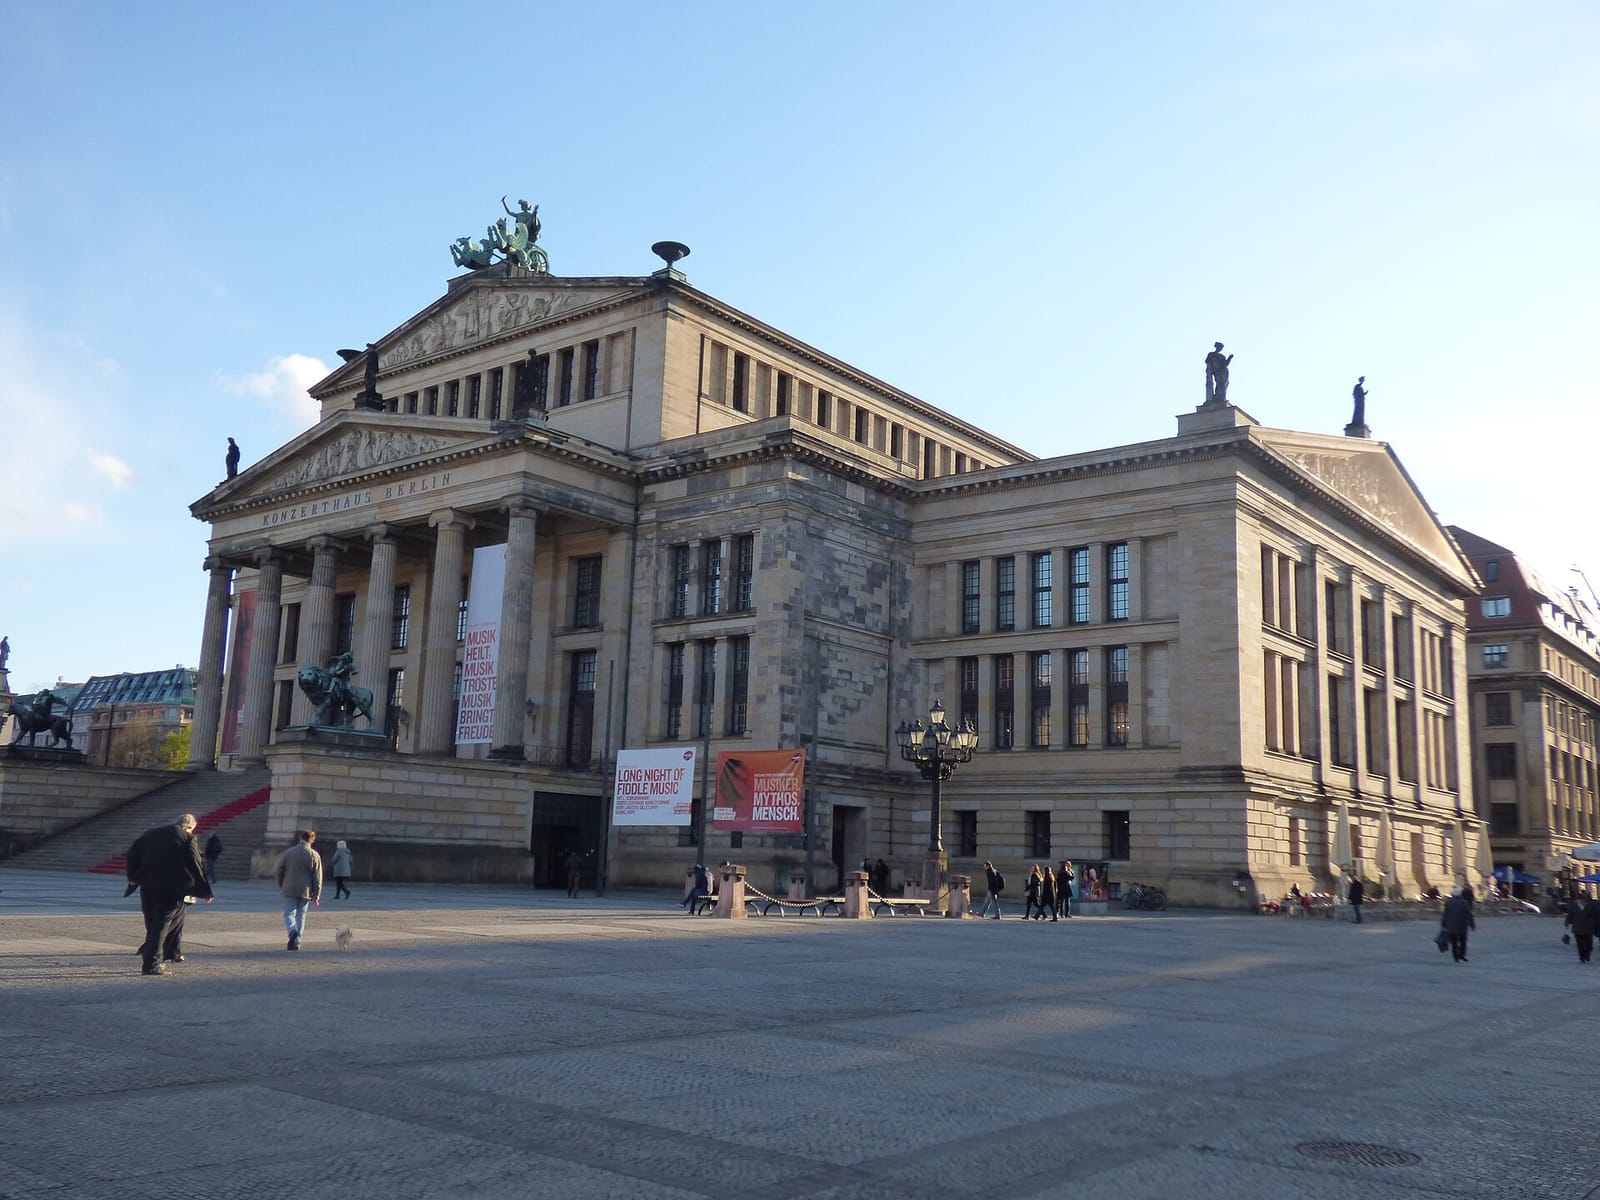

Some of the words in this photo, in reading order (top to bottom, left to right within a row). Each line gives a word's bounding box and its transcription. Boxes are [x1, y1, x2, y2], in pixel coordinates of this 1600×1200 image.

[263, 492, 371, 526] KONZERTHAUS
[385, 473, 450, 499] BERLIN
[467, 628, 496, 646] MUSIK
[464, 661, 494, 677] MUSIK
[461, 693, 492, 709] MUSIK
[460, 708, 495, 725] BRINGT
[618, 769, 642, 782] LONG
[644, 768, 672, 782] NIGHT
[674, 768, 685, 781] OF
[617, 782, 648, 795] FIDDLE
[650, 782, 679, 795] MUSIC
[754, 777, 801, 792] MUSIKER.
[753, 792, 800, 806] MYTHOS.
[752, 806, 800, 821] MENSCH.
